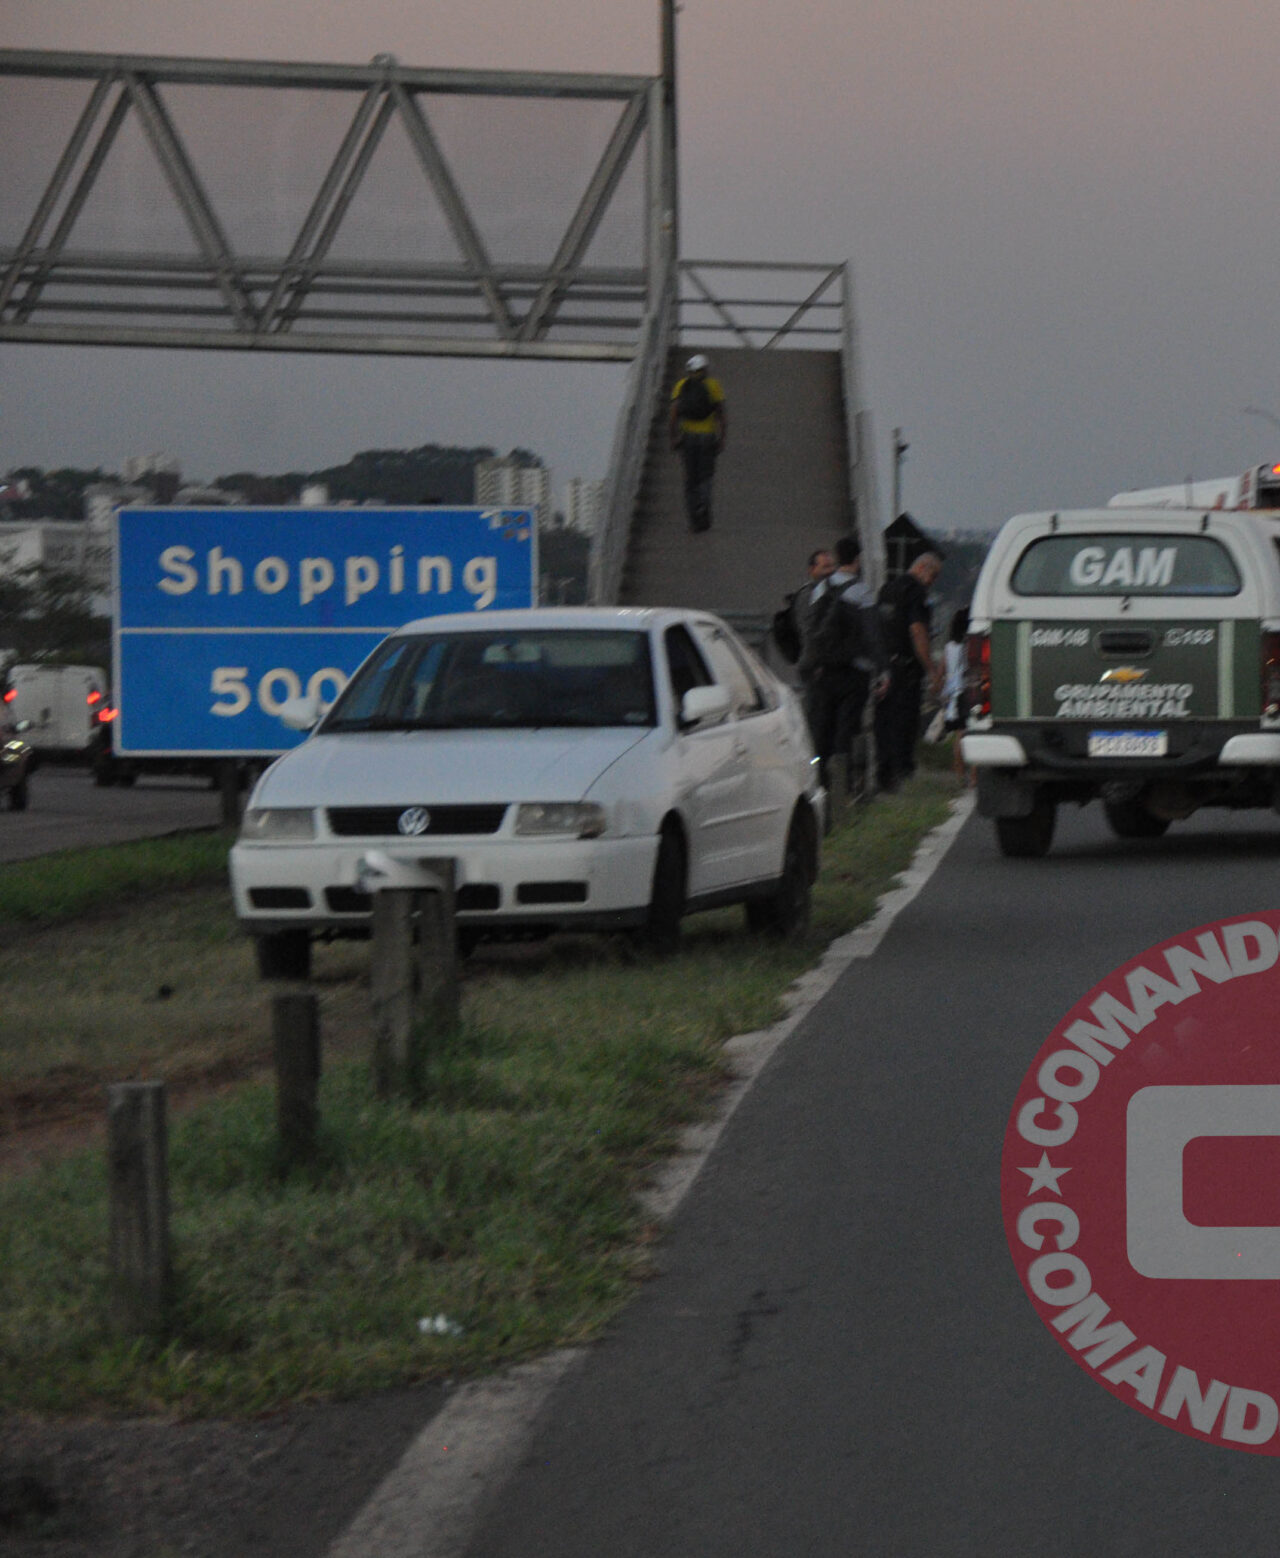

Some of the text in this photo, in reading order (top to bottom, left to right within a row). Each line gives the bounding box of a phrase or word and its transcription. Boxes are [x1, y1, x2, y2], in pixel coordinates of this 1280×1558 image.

[157, 544, 498, 610] Shopping
[1070, 547, 1178, 587] GAM
[1053, 683, 1194, 701] GRUPAMENTO
[1055, 699, 1192, 718] AMBIENTAL
